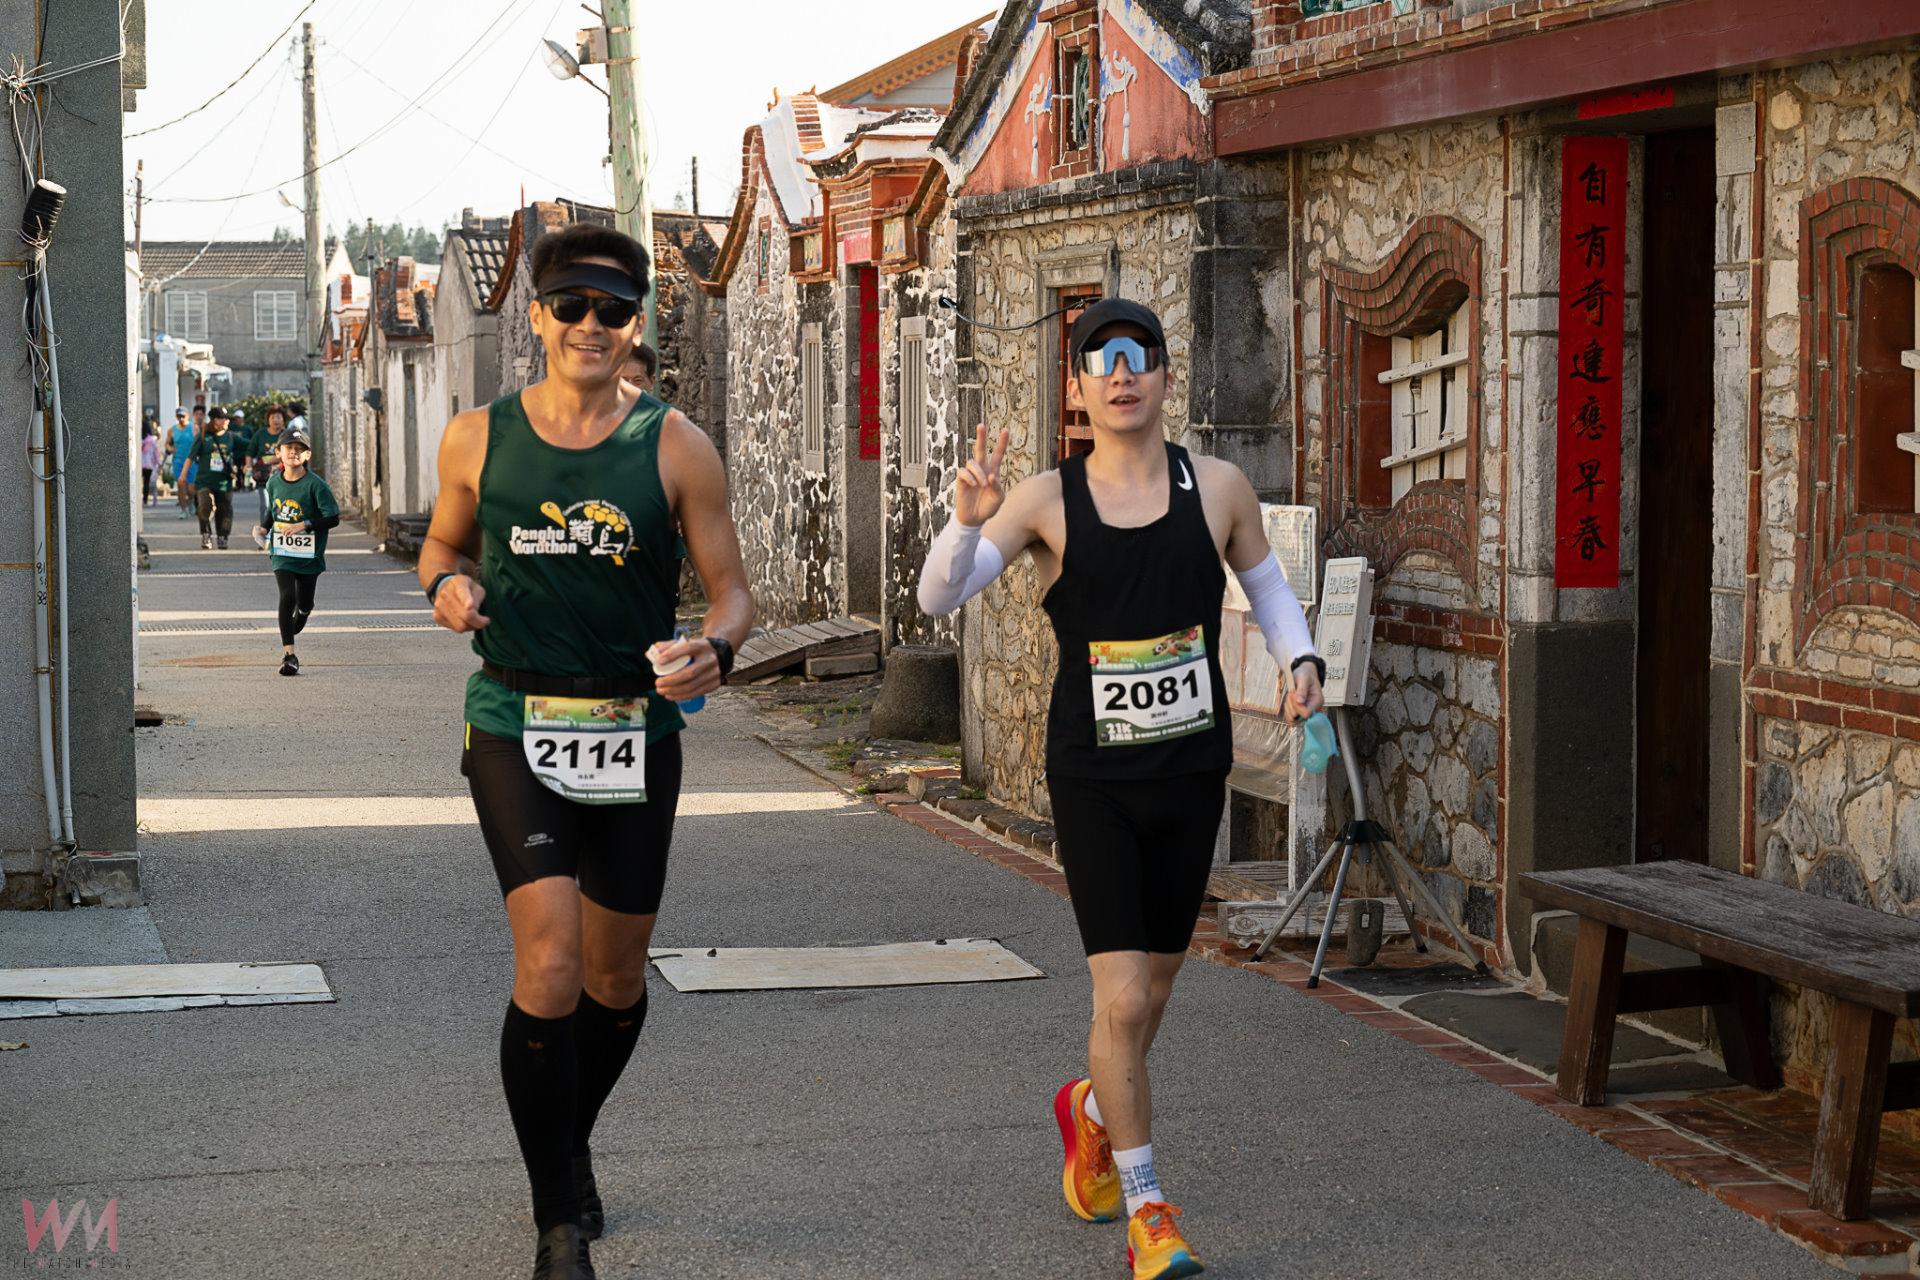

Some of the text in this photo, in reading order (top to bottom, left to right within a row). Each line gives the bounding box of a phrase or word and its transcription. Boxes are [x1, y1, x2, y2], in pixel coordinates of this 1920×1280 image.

[276, 535, 312, 547] 1062
[511, 525, 566, 543] Penghu
[509, 539, 578, 555] Marathon
[1103, 669, 1199, 711] 2081
[534, 738, 635, 769] 2114
